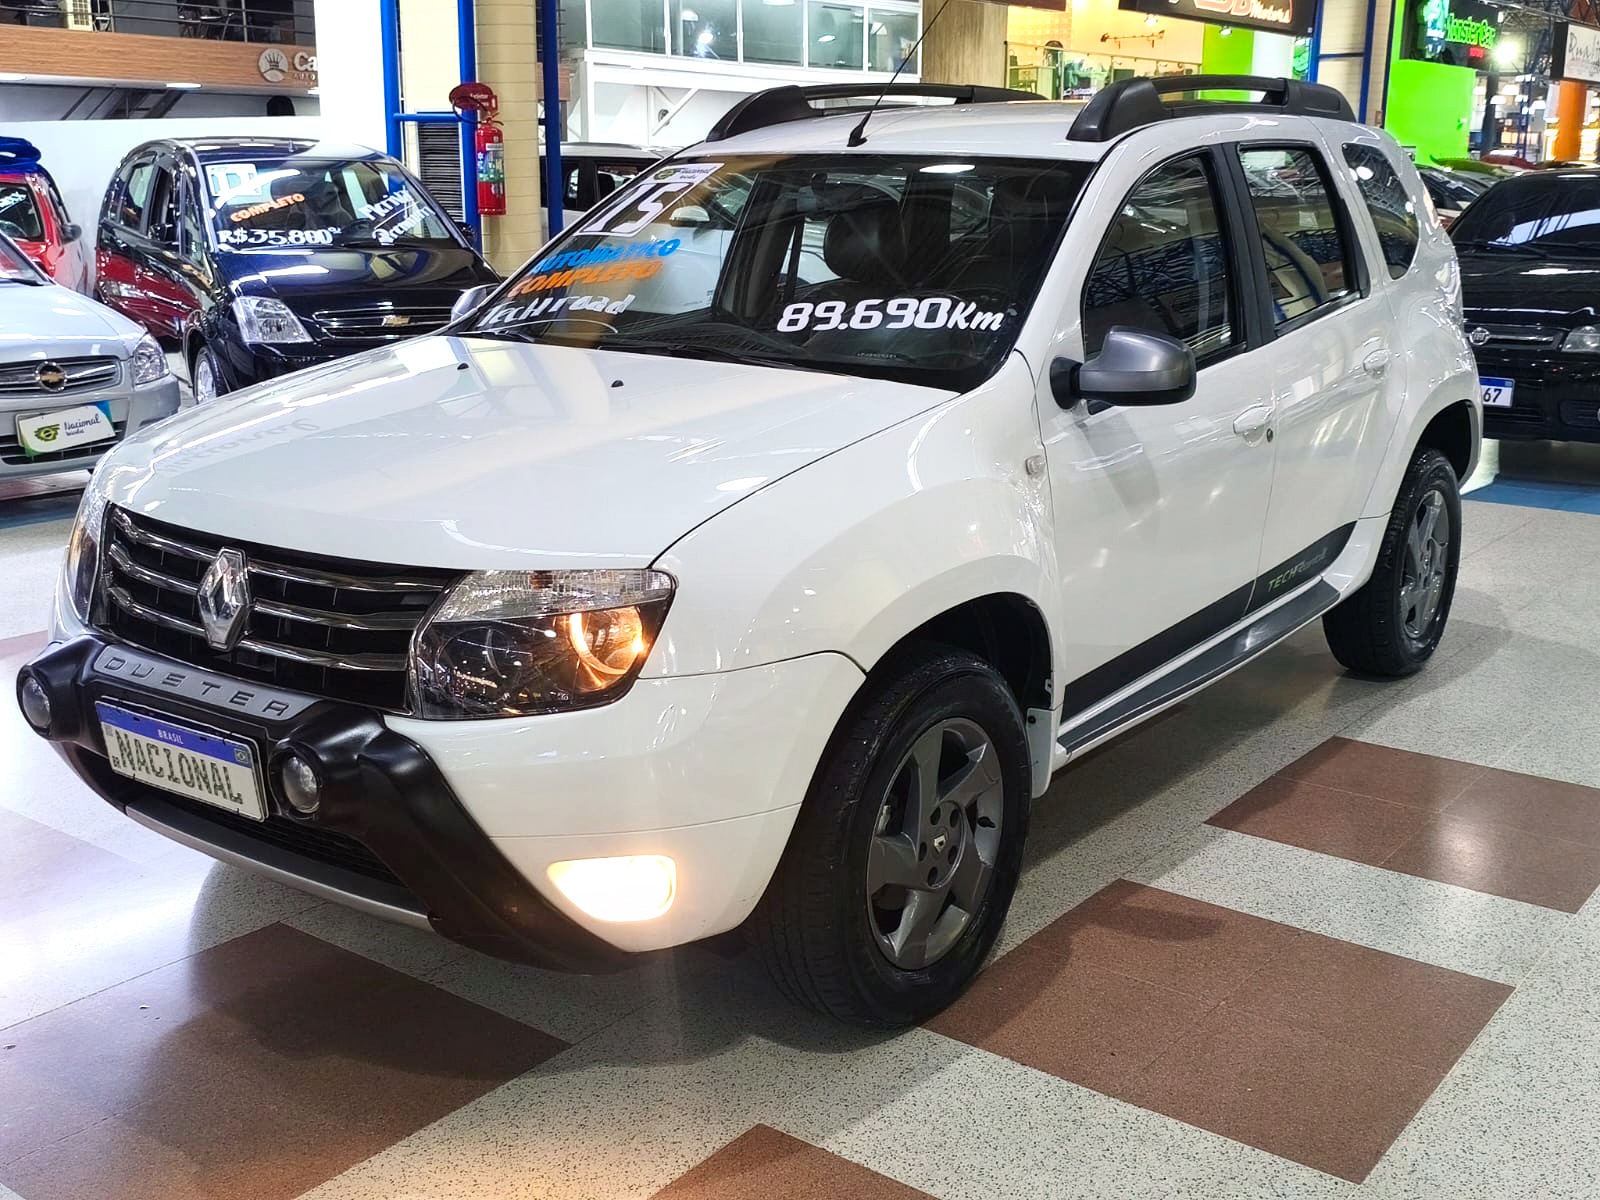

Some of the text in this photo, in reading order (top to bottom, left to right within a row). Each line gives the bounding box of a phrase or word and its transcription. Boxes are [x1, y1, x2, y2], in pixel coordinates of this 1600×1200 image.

[230, 193, 305, 222] COMPLETO
[579, 182, 692, 233] 15
[507, 260, 663, 298] COMPLETO
[1483, 388, 1502, 403] 67
[64, 413, 101, 430] Nacional
[104, 656, 290, 717] DUSTER
[157, 729, 185, 746] BRASIL
[114, 729, 244, 806] NACIONAL
